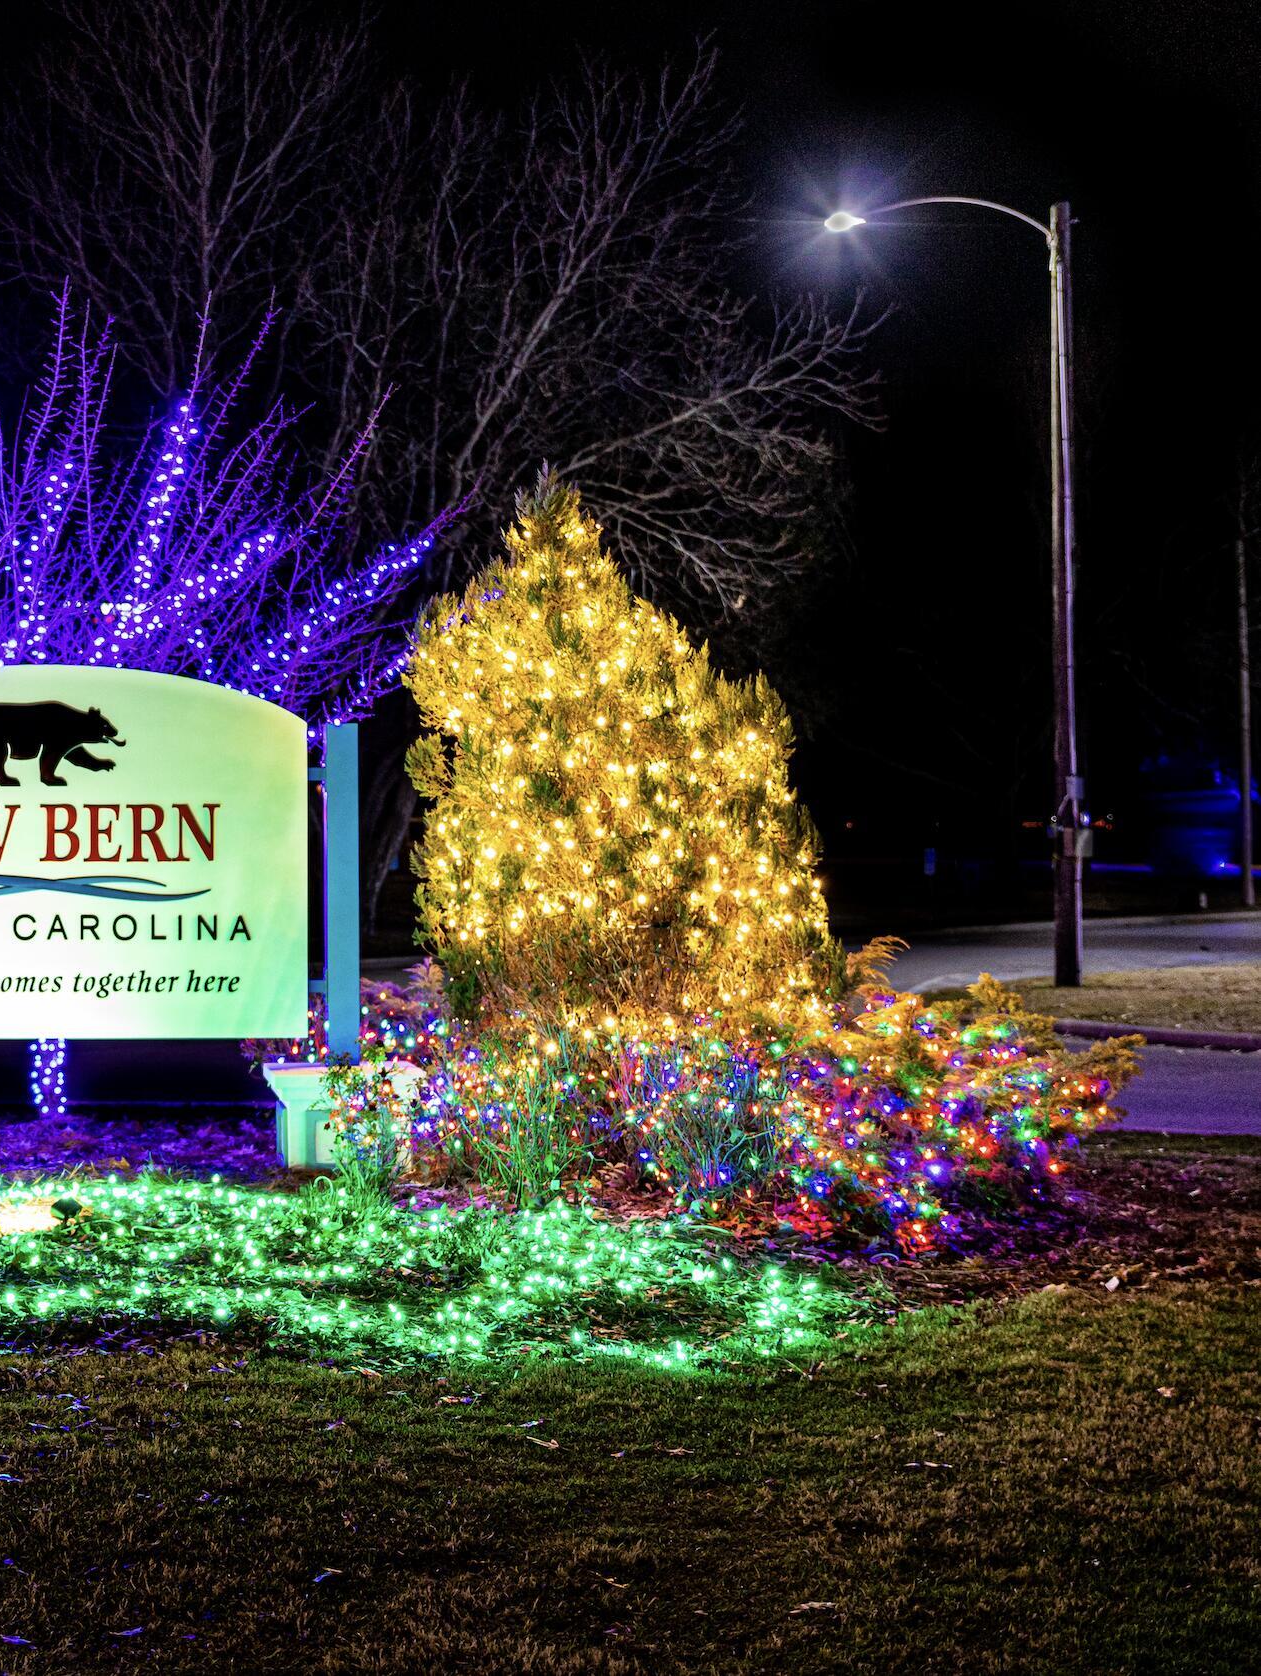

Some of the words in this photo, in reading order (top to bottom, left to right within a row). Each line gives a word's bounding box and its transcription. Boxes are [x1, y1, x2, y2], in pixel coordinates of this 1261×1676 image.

[40, 804, 221, 862] BERN
[12, 914, 252, 941] CAROLINA
[72, 970, 180, 998] together
[186, 970, 241, 993] here
